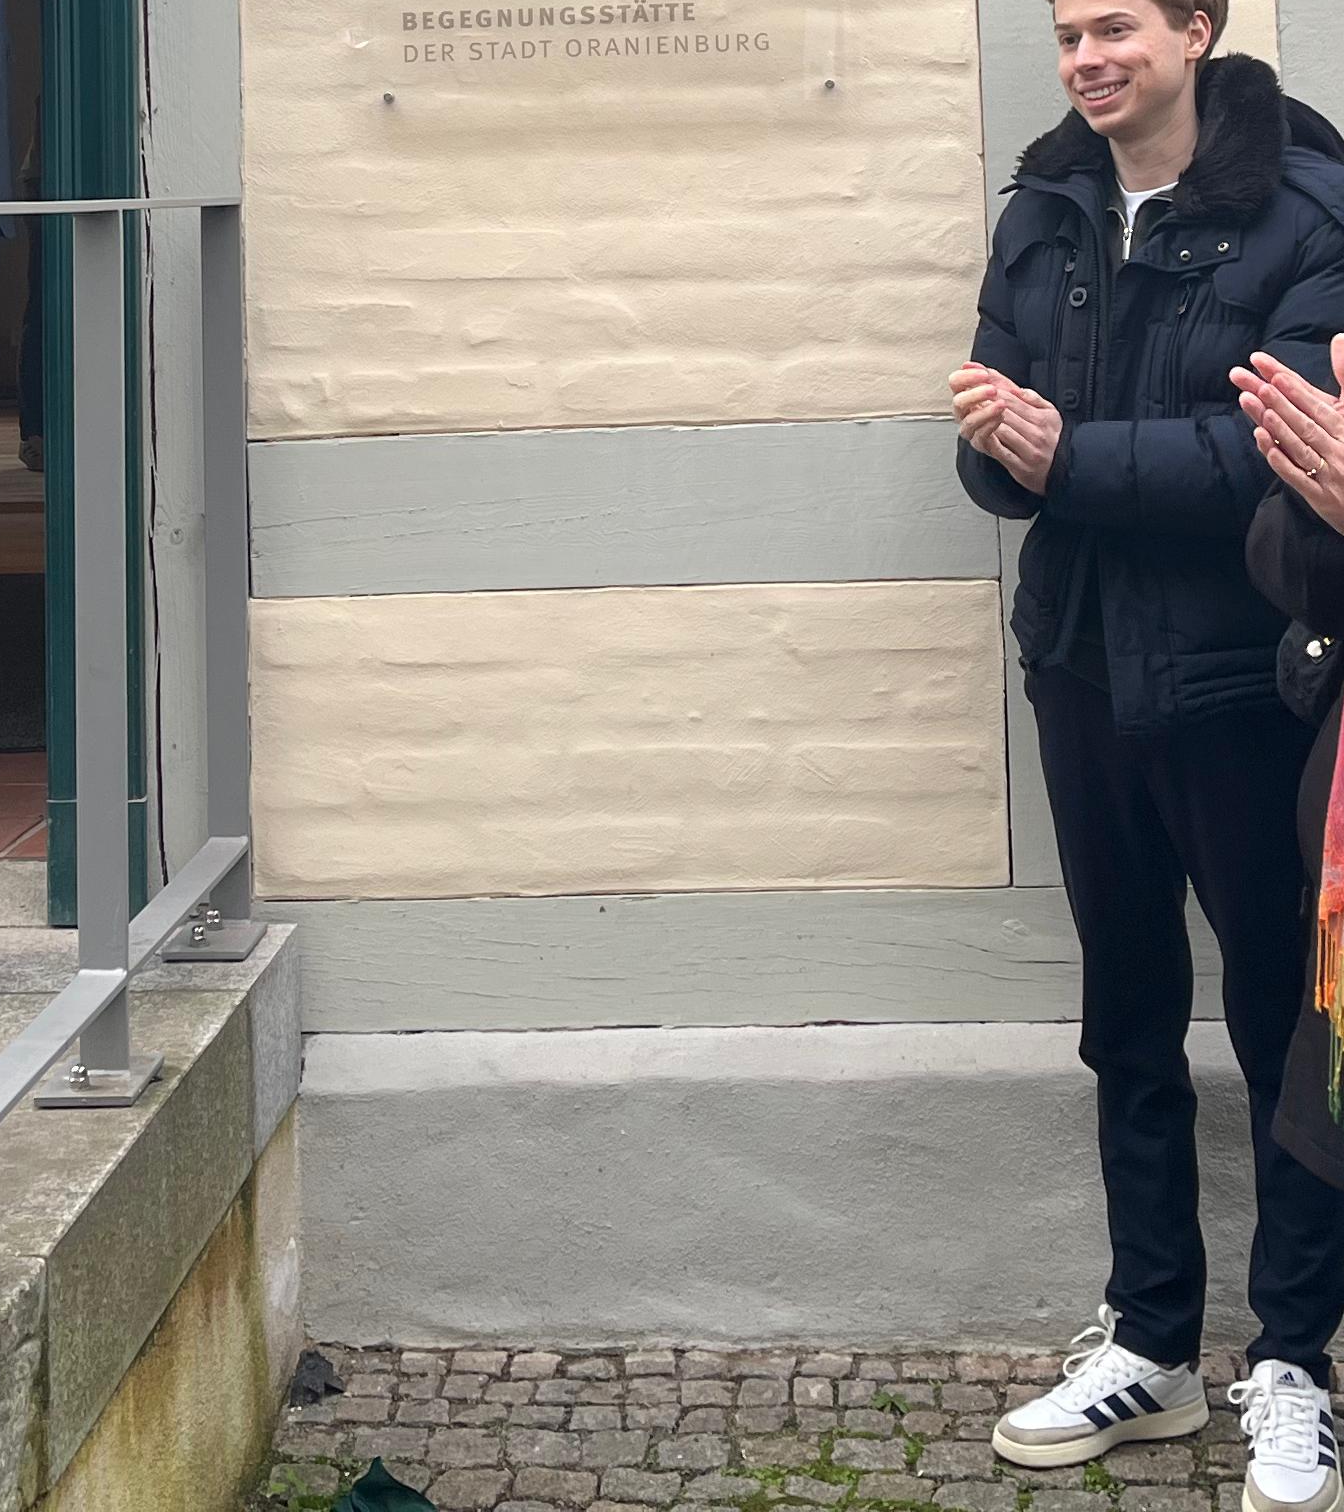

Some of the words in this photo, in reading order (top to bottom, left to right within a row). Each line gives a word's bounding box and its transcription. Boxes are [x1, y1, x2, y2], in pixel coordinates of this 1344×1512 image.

[403, 43, 455, 63] DER
[468, 40, 552, 61] STADT
[565, 32, 770, 58] ORANIENBURG
